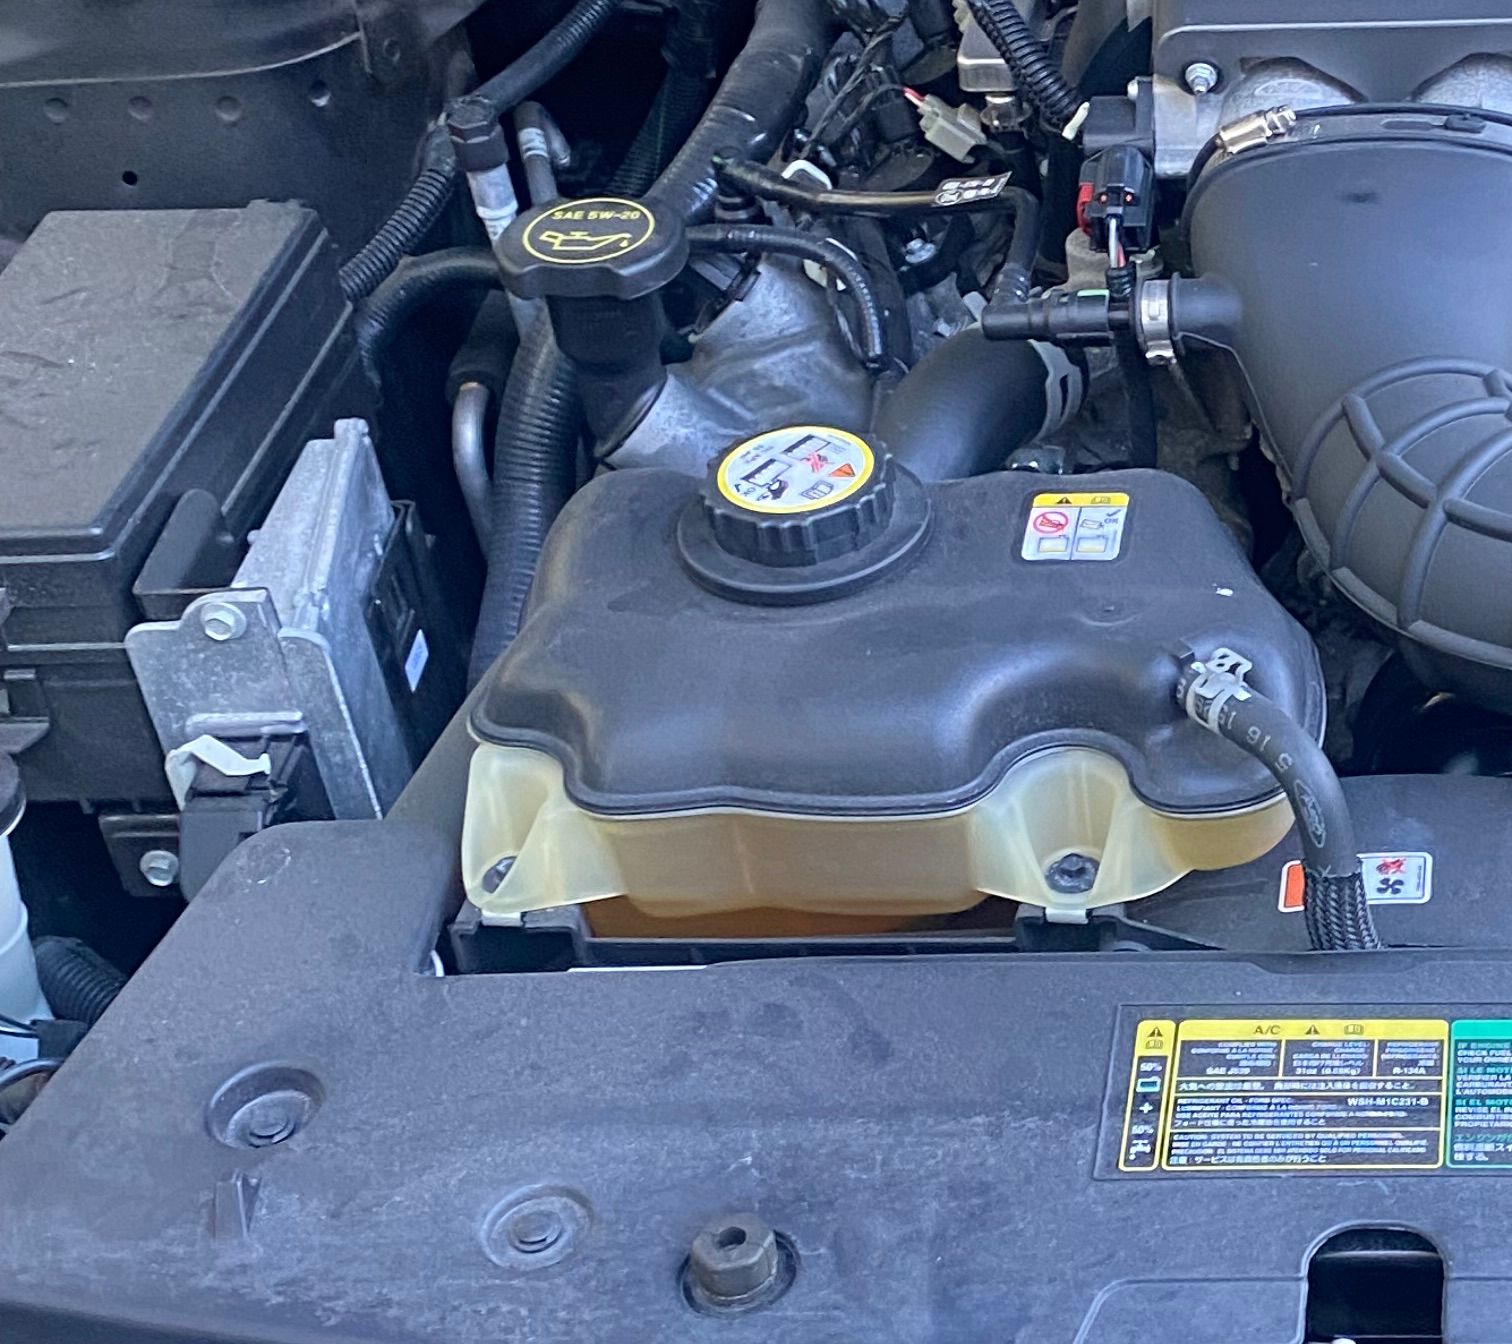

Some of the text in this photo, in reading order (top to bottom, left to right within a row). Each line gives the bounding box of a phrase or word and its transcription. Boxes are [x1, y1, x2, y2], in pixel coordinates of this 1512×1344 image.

[552, 210, 641, 220] SAE 5W-20
[1247, 726, 1272, 751] 16
[1275, 753, 1293, 773] 5
[1255, 1025, 1281, 1035] A/C
[1140, 1062, 1163, 1072] 50%
[1392, 1067, 1427, 1075] R-134A
[1470, 1066, 1484, 1074] LE
[1131, 1124, 1154, 1135] 50%
